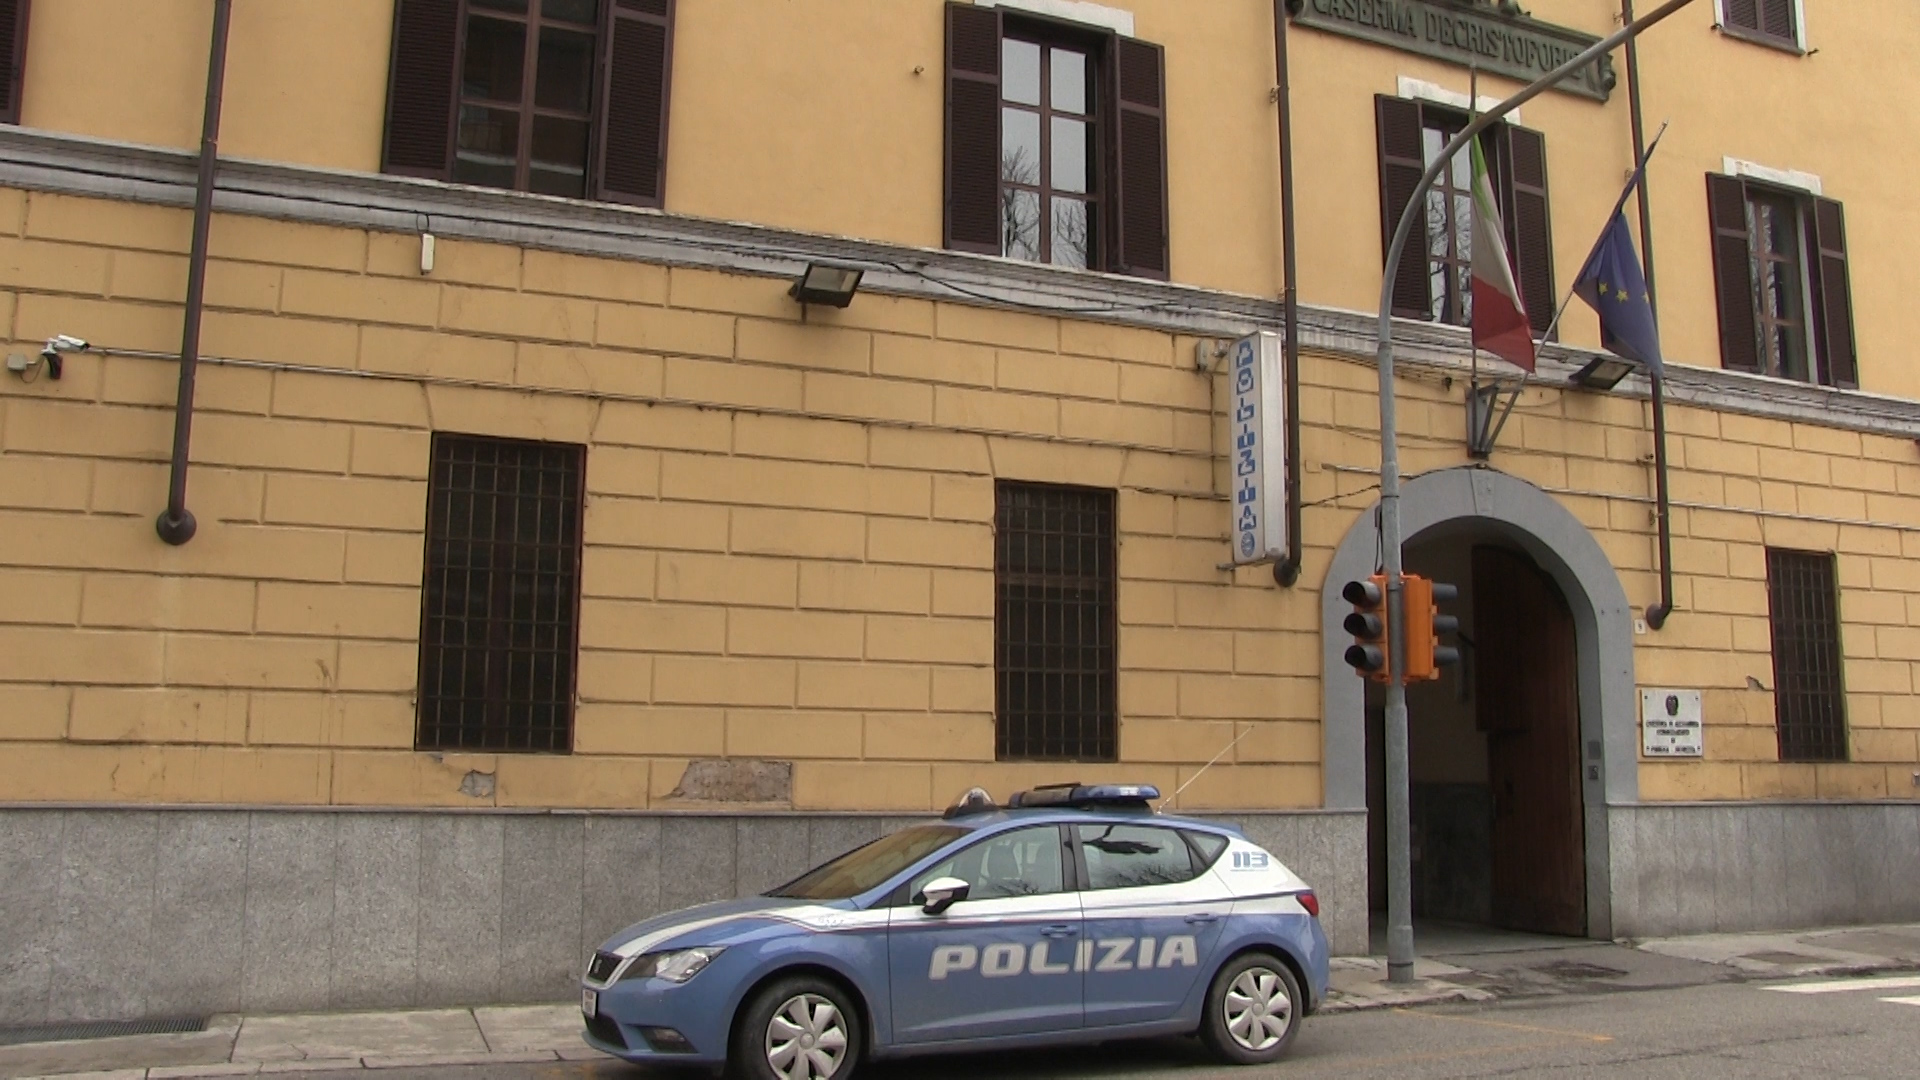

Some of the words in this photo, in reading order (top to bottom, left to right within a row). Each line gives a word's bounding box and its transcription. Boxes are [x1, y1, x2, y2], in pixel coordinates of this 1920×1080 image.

[1236, 341, 1257, 532] POLIZIA
[1231, 851, 1269, 868] 113
[928, 934, 1198, 981] POLIZIA
